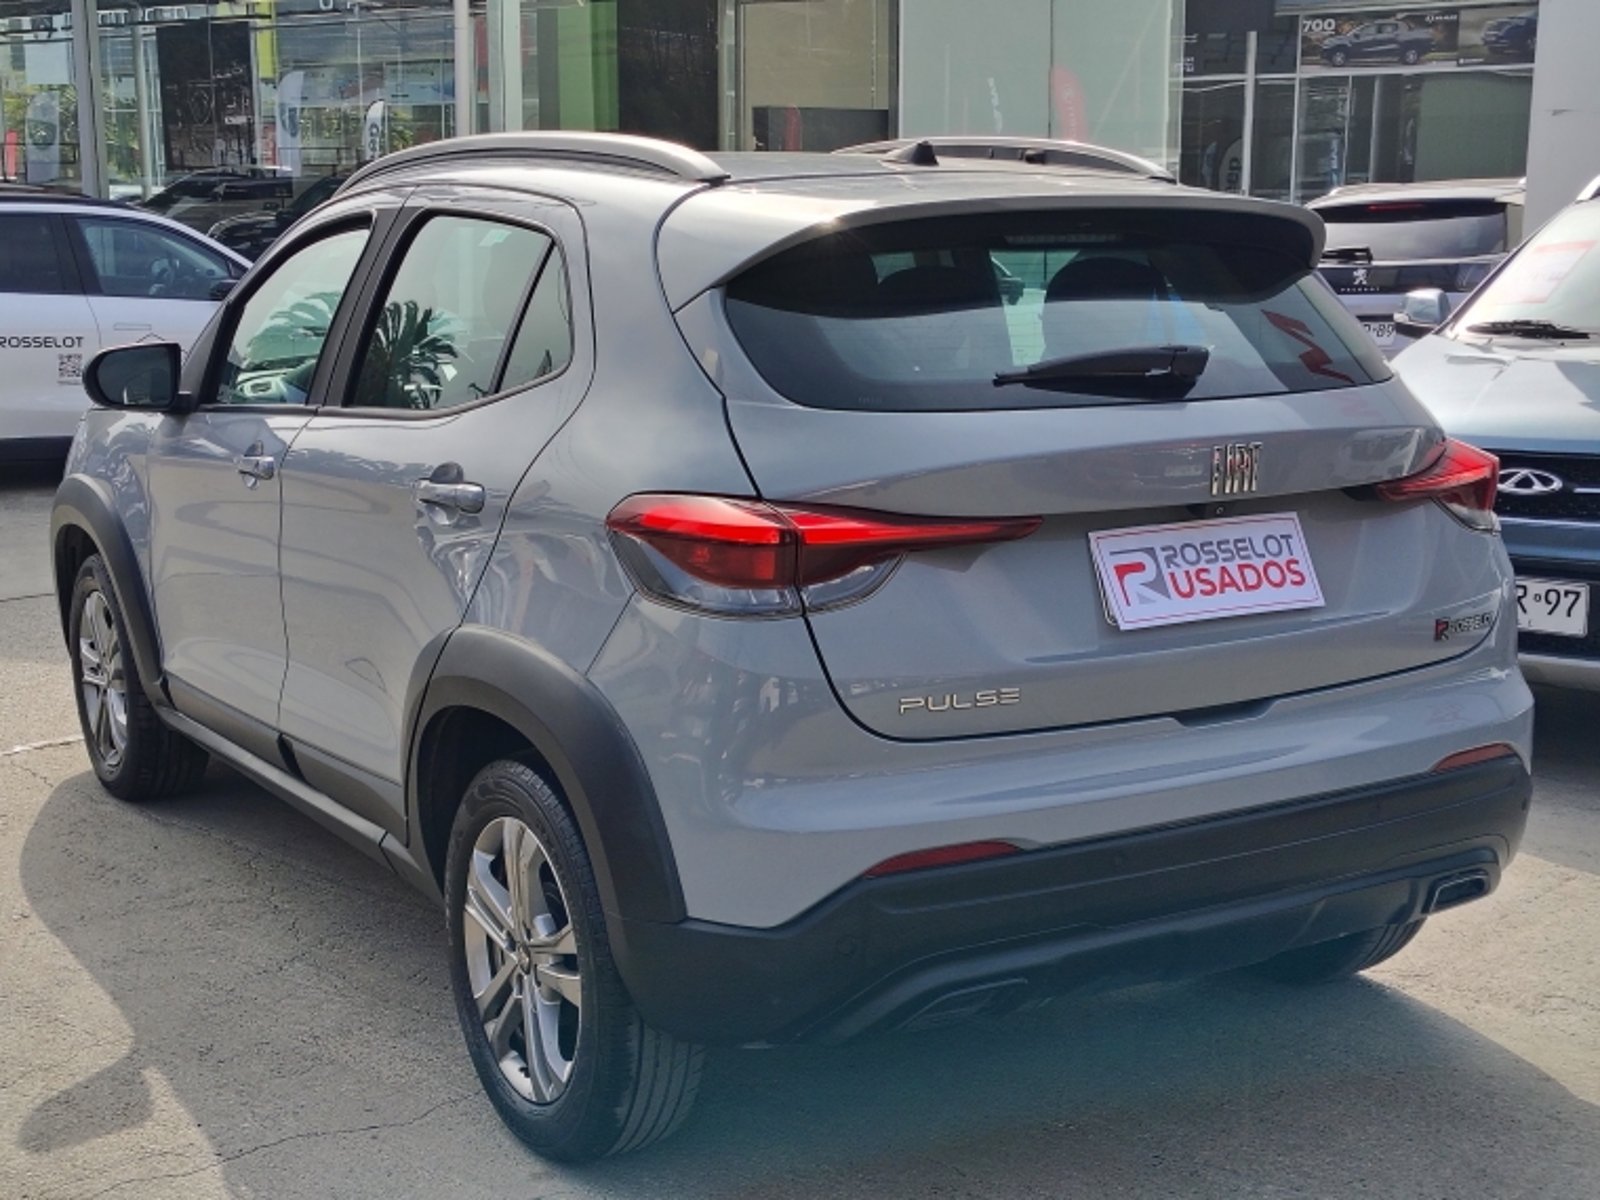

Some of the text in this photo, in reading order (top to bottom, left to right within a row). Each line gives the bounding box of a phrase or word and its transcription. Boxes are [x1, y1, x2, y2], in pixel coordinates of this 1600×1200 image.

[1161, 534, 1294, 568] ROSSELOT
[1170, 558, 1306, 599] USADOS
[899, 687, 1020, 714] PULSE
